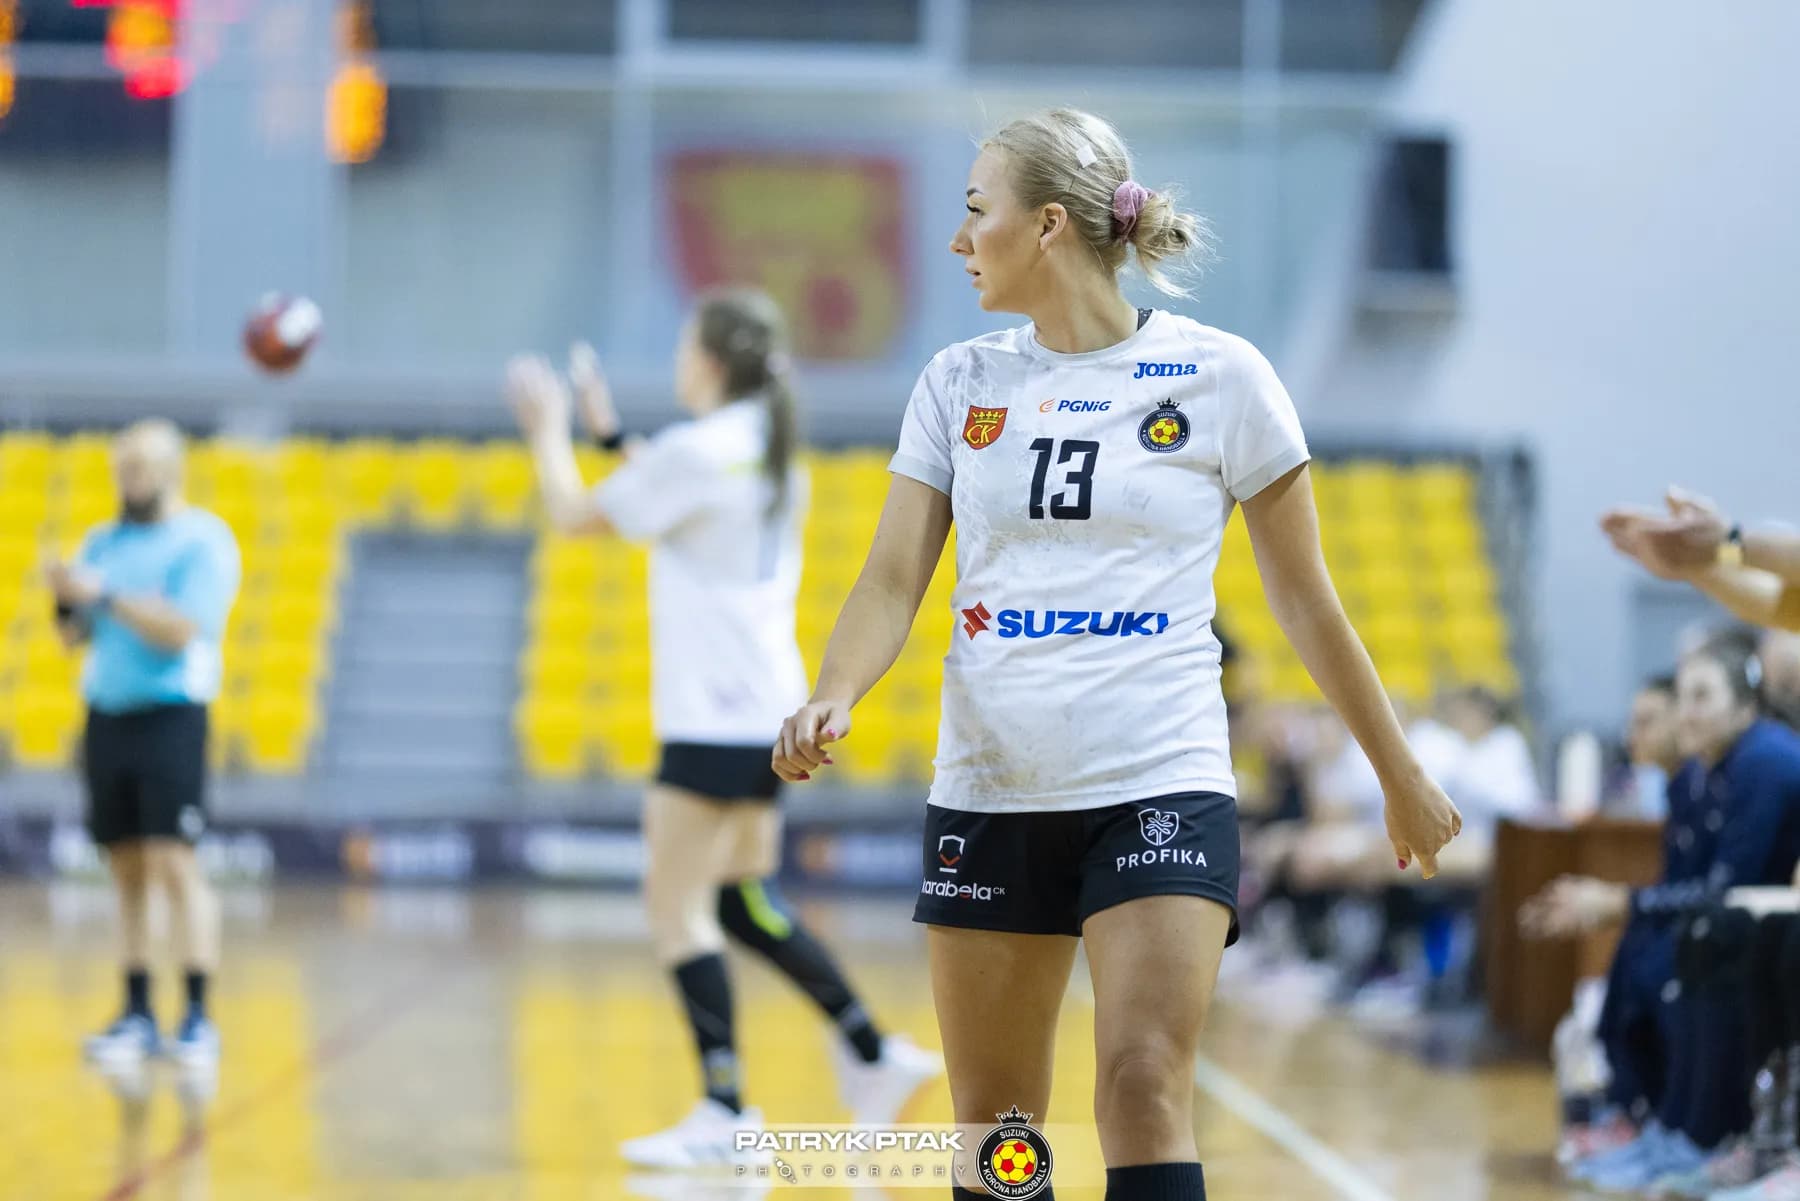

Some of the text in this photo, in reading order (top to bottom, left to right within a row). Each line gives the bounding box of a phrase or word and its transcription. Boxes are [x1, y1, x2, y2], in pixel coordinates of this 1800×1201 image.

[1134, 362, 1198, 379] Joma
[1057, 400, 1112, 412] PGNiG
[966, 424, 996, 444] CK
[1029, 438, 1100, 520] 13
[997, 609, 1169, 638] SUZUKI
[1116, 849, 1207, 872] PROFIKA
